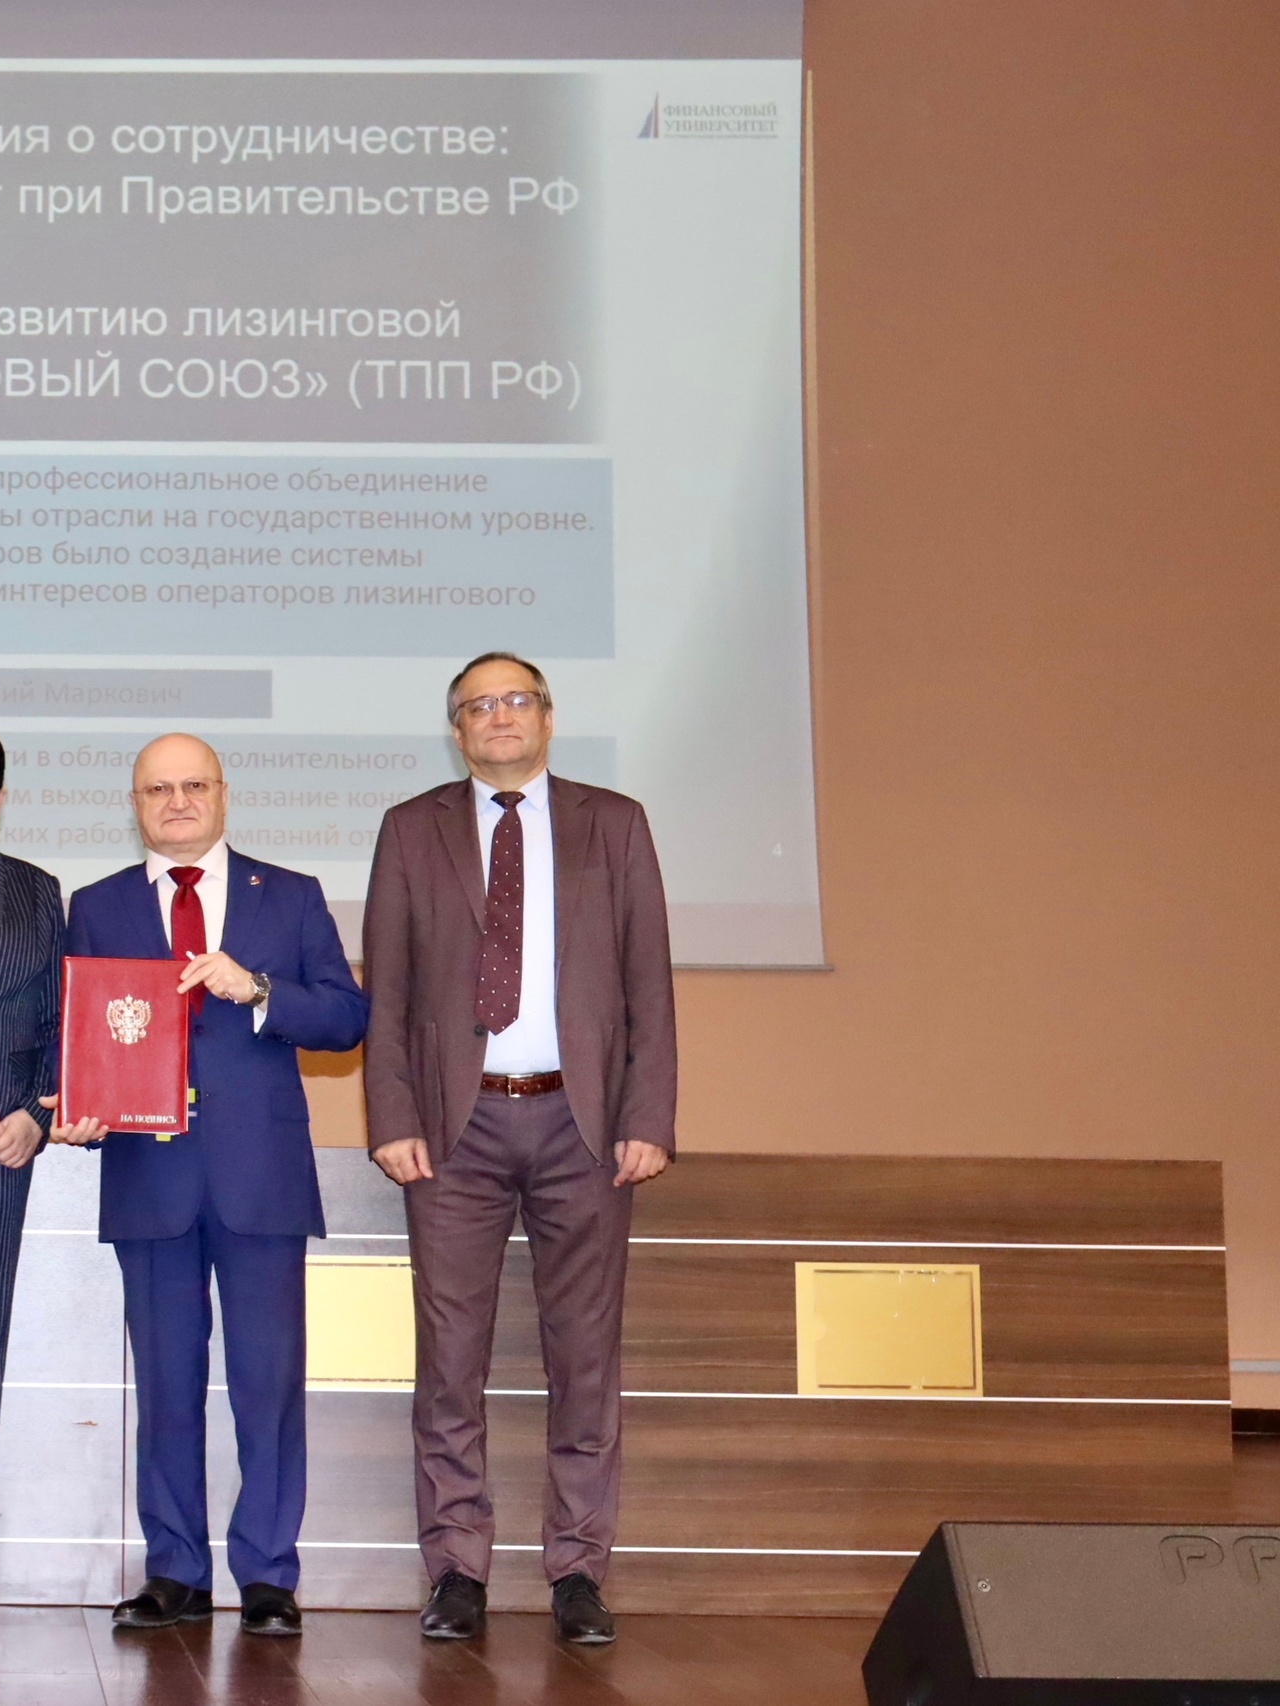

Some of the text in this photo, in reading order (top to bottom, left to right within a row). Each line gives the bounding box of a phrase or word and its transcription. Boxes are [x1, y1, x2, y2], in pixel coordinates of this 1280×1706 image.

[664, 103, 777, 116] ФИНАНСОВЫЙ
[664, 120, 777, 132] УНИВЕРСИТЕТ
[68, 125, 95, 154] о
[111, 124, 510, 164] сотрудничестве:
[19, 184, 102, 223] при
[121, 176, 490, 223] Правительстве
[509, 176, 580, 215] РФ
[183, 300, 461, 338] лизинговой
[139, 358, 328, 400] СОЮЗ»
[349, 358, 471, 410] (ТПП
[491, 359, 582, 411] РФ)
[288, 468, 489, 494] объединение
[32, 508, 153, 532] отрасли
[163, 509, 198, 527] на
[208, 509, 472, 534] государственном
[481, 511, 595, 536] уровне.
[53, 541, 130, 565] было
[140, 545, 281, 570] создание
[291, 547, 423, 567] системы
[157, 583, 335, 609] операторов
[344, 585, 536, 606] лизингового
[45, 682, 182, 706] Маркович
[38, 751, 50, 767] в
[60, 745, 136, 767] облас
[220, 751, 417, 769] олнительного
[230, 790, 338, 808] казание
[223, 824, 339, 846] омпаний
[120, 1114, 177, 1124] НА ПОДПИСЬ
